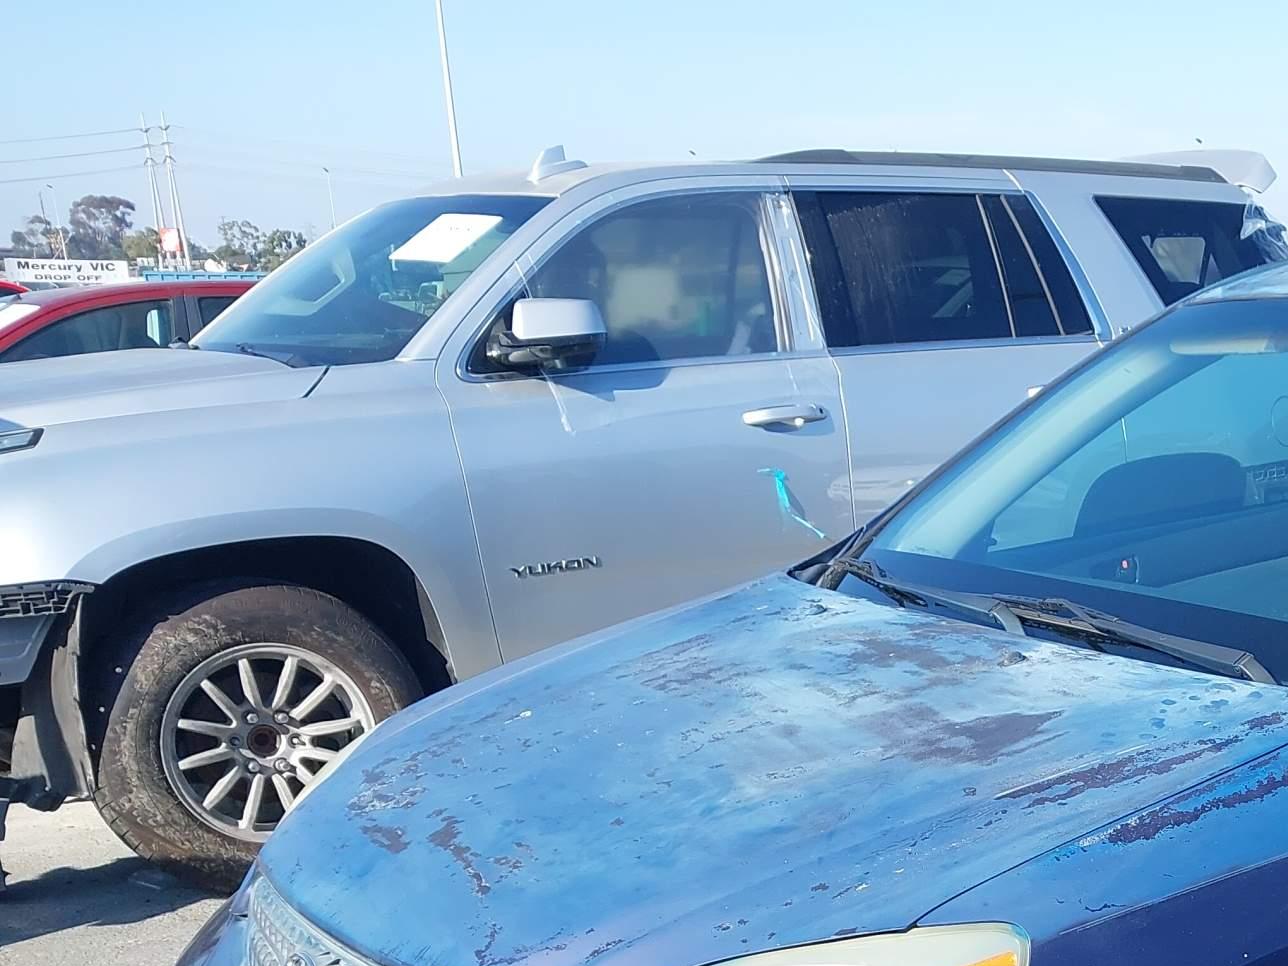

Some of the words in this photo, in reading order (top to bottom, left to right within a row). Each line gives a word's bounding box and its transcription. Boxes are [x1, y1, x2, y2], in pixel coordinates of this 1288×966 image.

[16, 261, 83, 272] Mercury
[89, 262, 116, 272] VIC
[34, 273, 72, 281] DROP
[509, 555, 602, 578] YUKON
